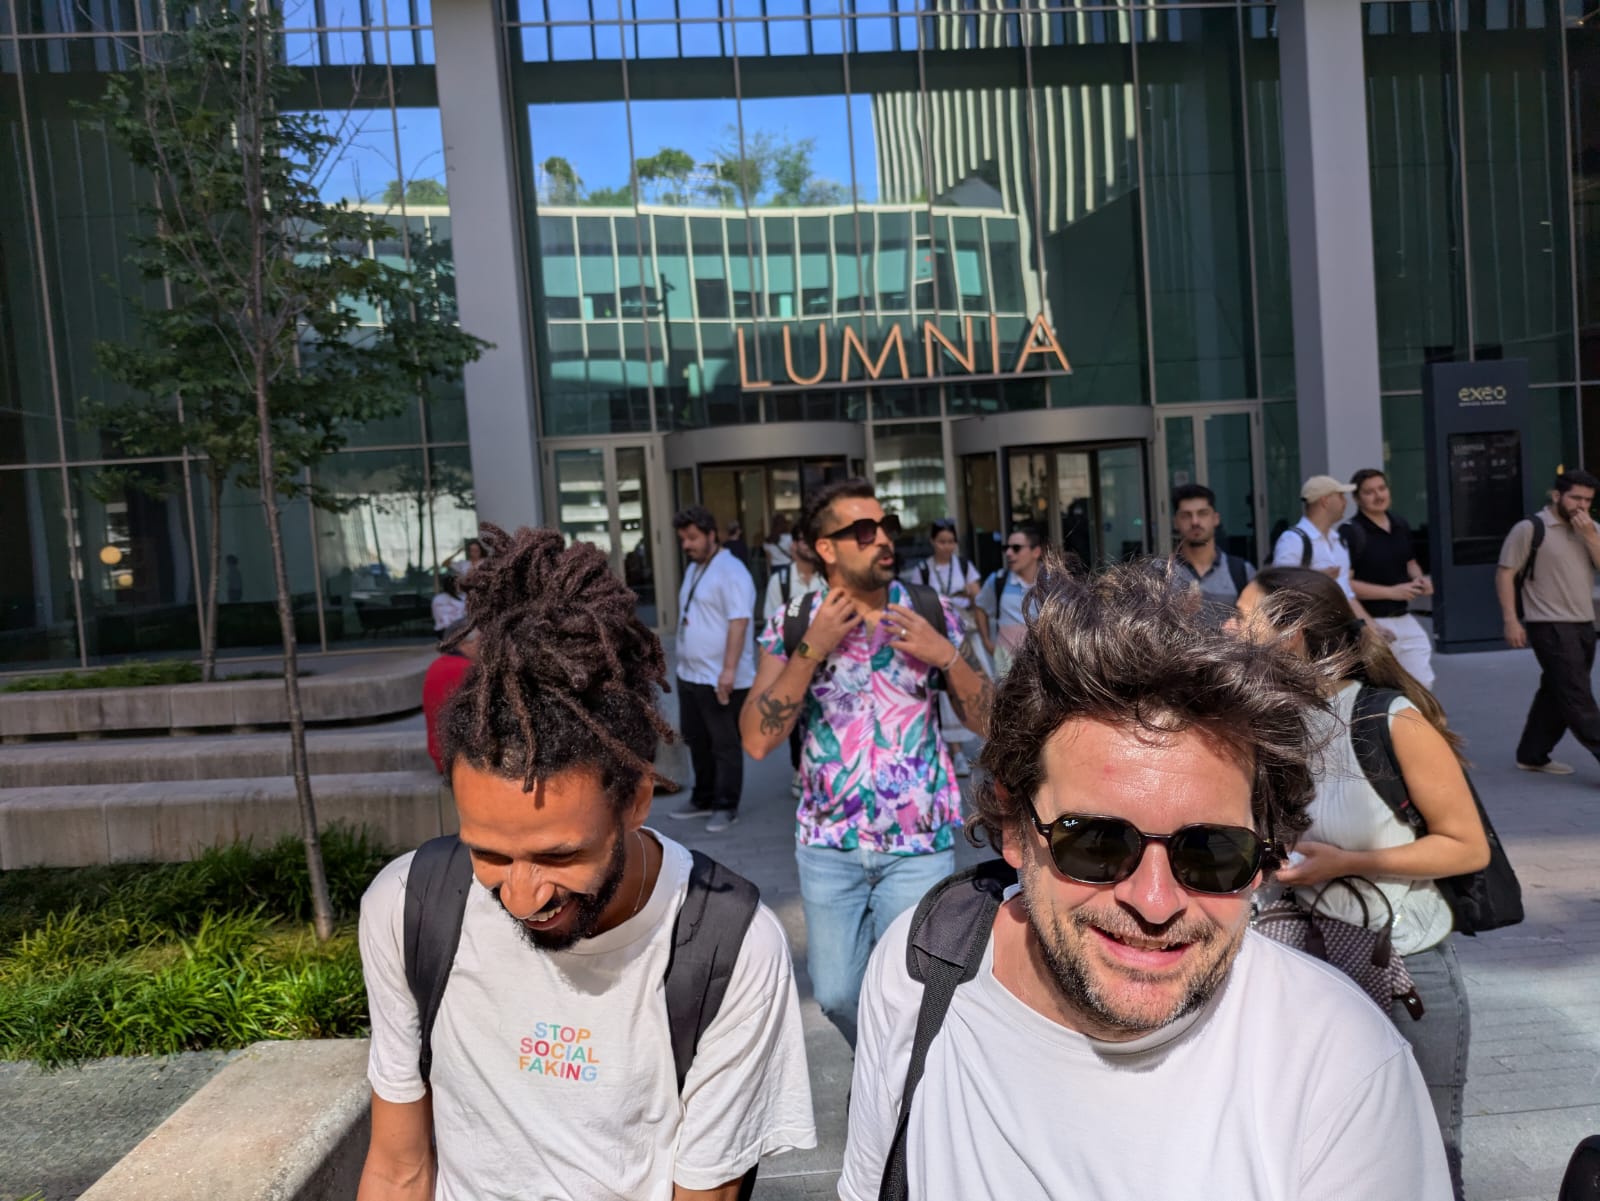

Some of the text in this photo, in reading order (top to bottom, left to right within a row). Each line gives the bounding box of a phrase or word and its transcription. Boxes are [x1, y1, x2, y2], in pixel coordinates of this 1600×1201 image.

[738, 313, 1072, 389] LUMNIA
[1458, 386, 1507, 401] exeo
[534, 1021, 592, 1044] STOP
[520, 1036, 600, 1064] SOCIAL
[519, 1055, 598, 1082] FAKING
